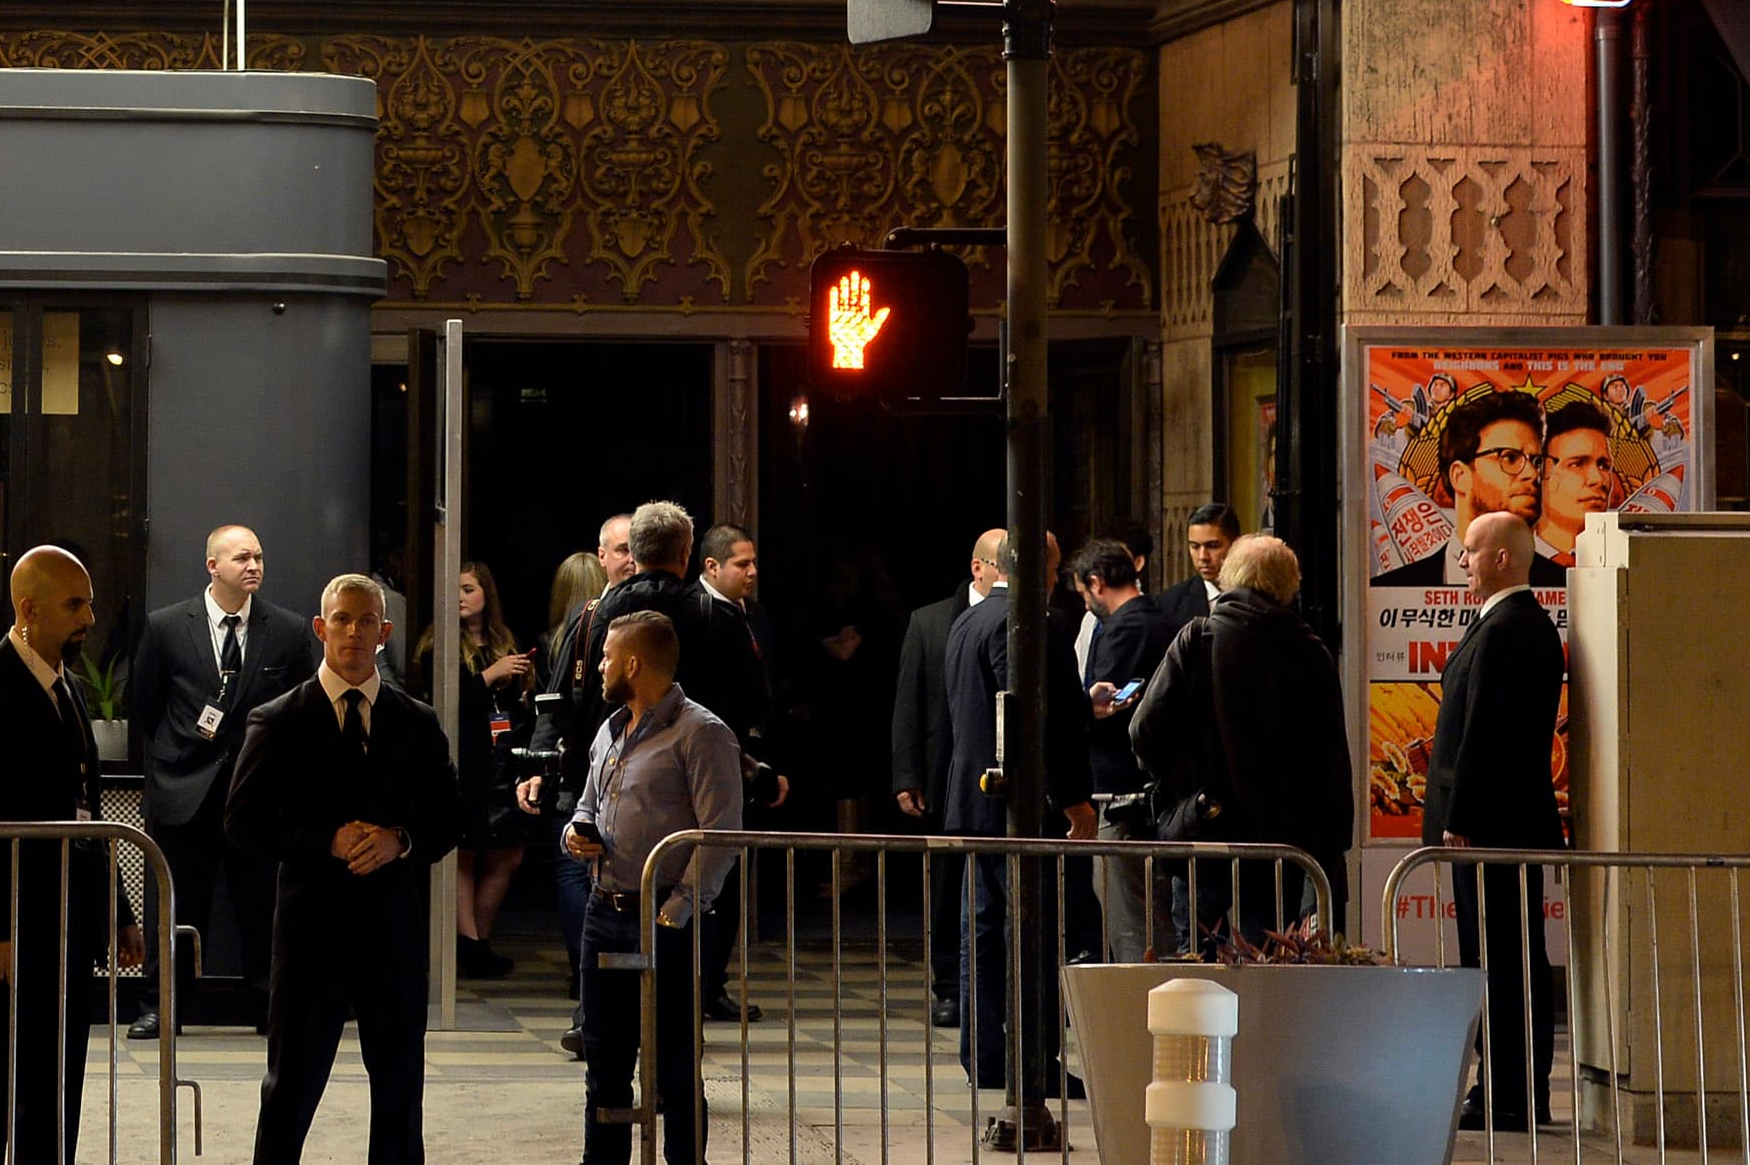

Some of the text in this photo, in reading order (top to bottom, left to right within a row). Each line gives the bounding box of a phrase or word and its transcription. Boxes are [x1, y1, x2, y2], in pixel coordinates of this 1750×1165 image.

[1422, 351, 1439, 360] THE
[1424, 590, 1459, 605] SETH
[1400, 608, 1455, 627] 무식한
